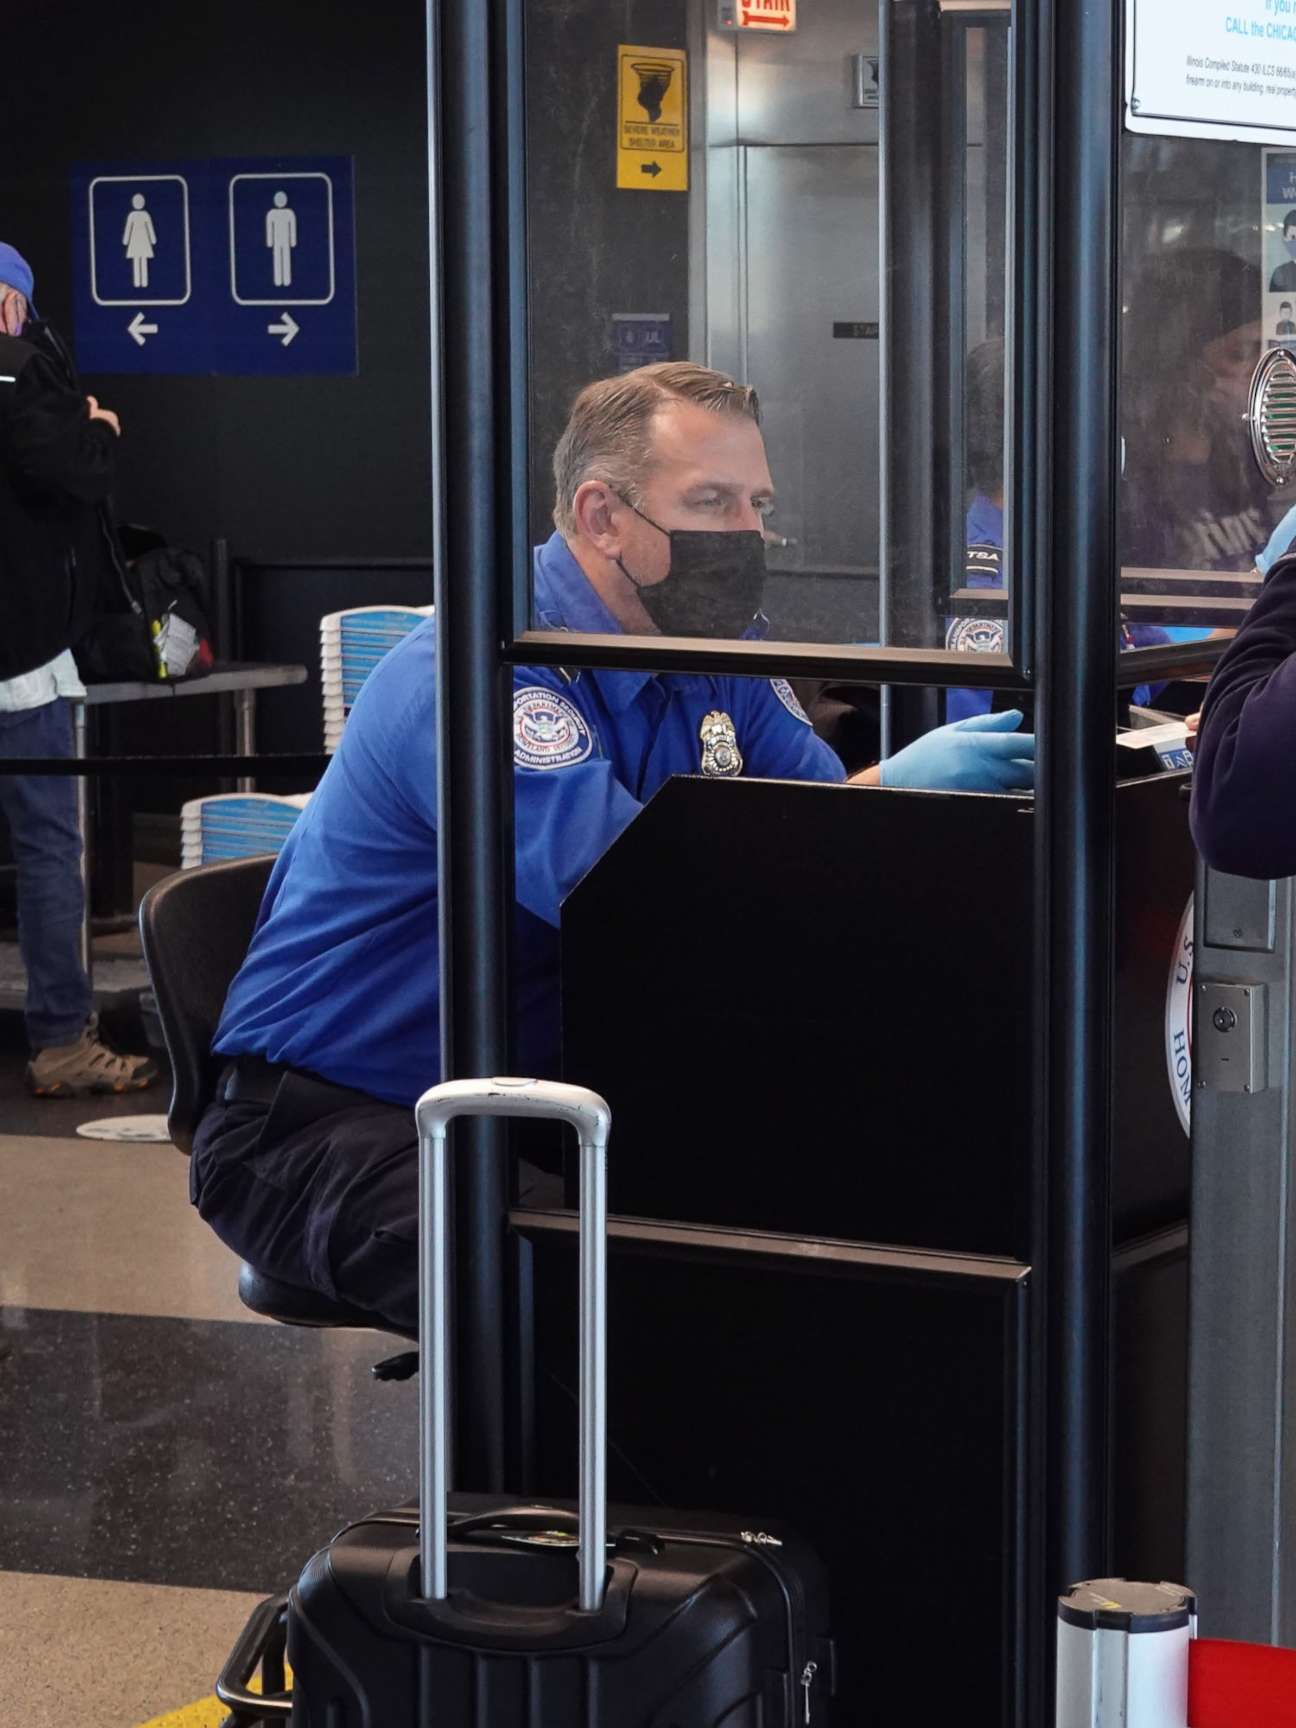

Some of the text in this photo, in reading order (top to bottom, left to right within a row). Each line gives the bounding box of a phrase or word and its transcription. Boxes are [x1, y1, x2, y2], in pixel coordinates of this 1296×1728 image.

[1274, 0, 1291, 16] you
[1225, 16, 1249, 36] CALL
[1251, 20, 1264, 38] the
[967, 550, 999, 561] TSA
